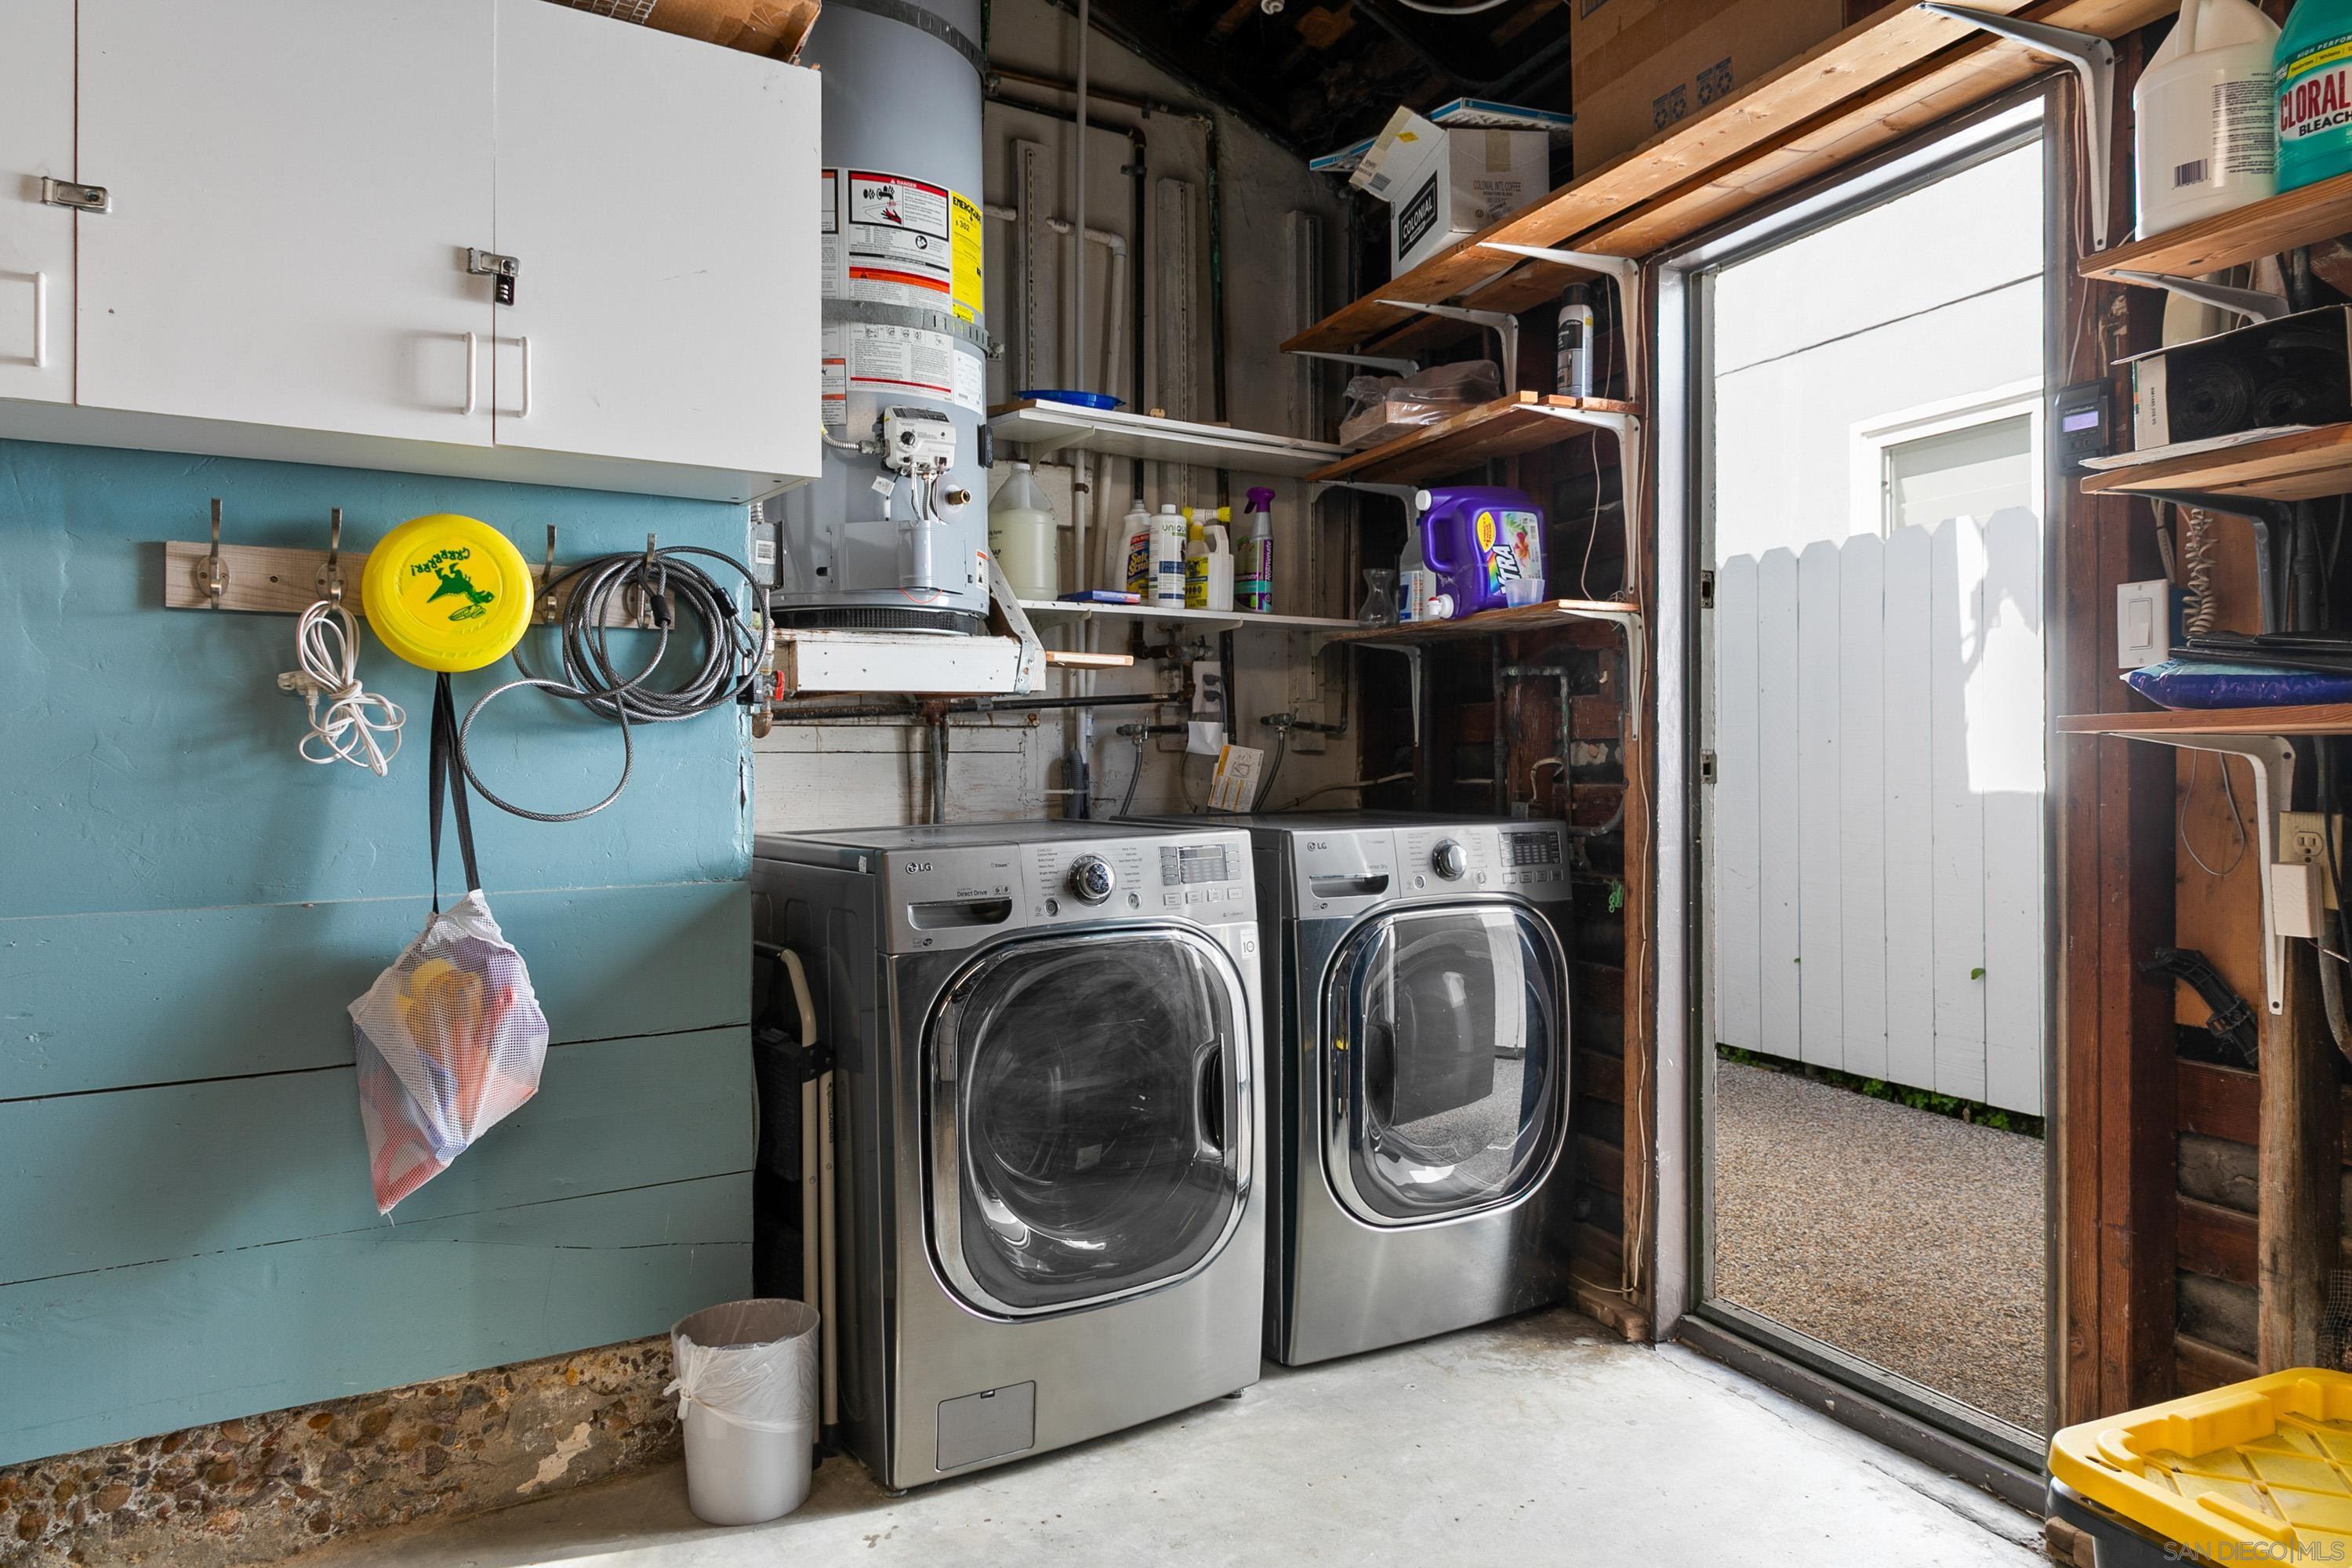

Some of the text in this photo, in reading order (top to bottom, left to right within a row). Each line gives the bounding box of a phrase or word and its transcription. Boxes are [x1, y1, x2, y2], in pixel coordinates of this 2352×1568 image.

[2297, 47, 2314, 60] HIGH
[2280, 70, 2351, 132] CLORAL
[2299, 111, 2352, 137] BLEACH
[896, 180, 917, 188] DANGER
[1504, 182, 1522, 192] COFFEE
[1403, 196, 1433, 238] COLONIAL
[960, 220, 971, 232] 302
[1130, 551, 1148, 564] Soft
